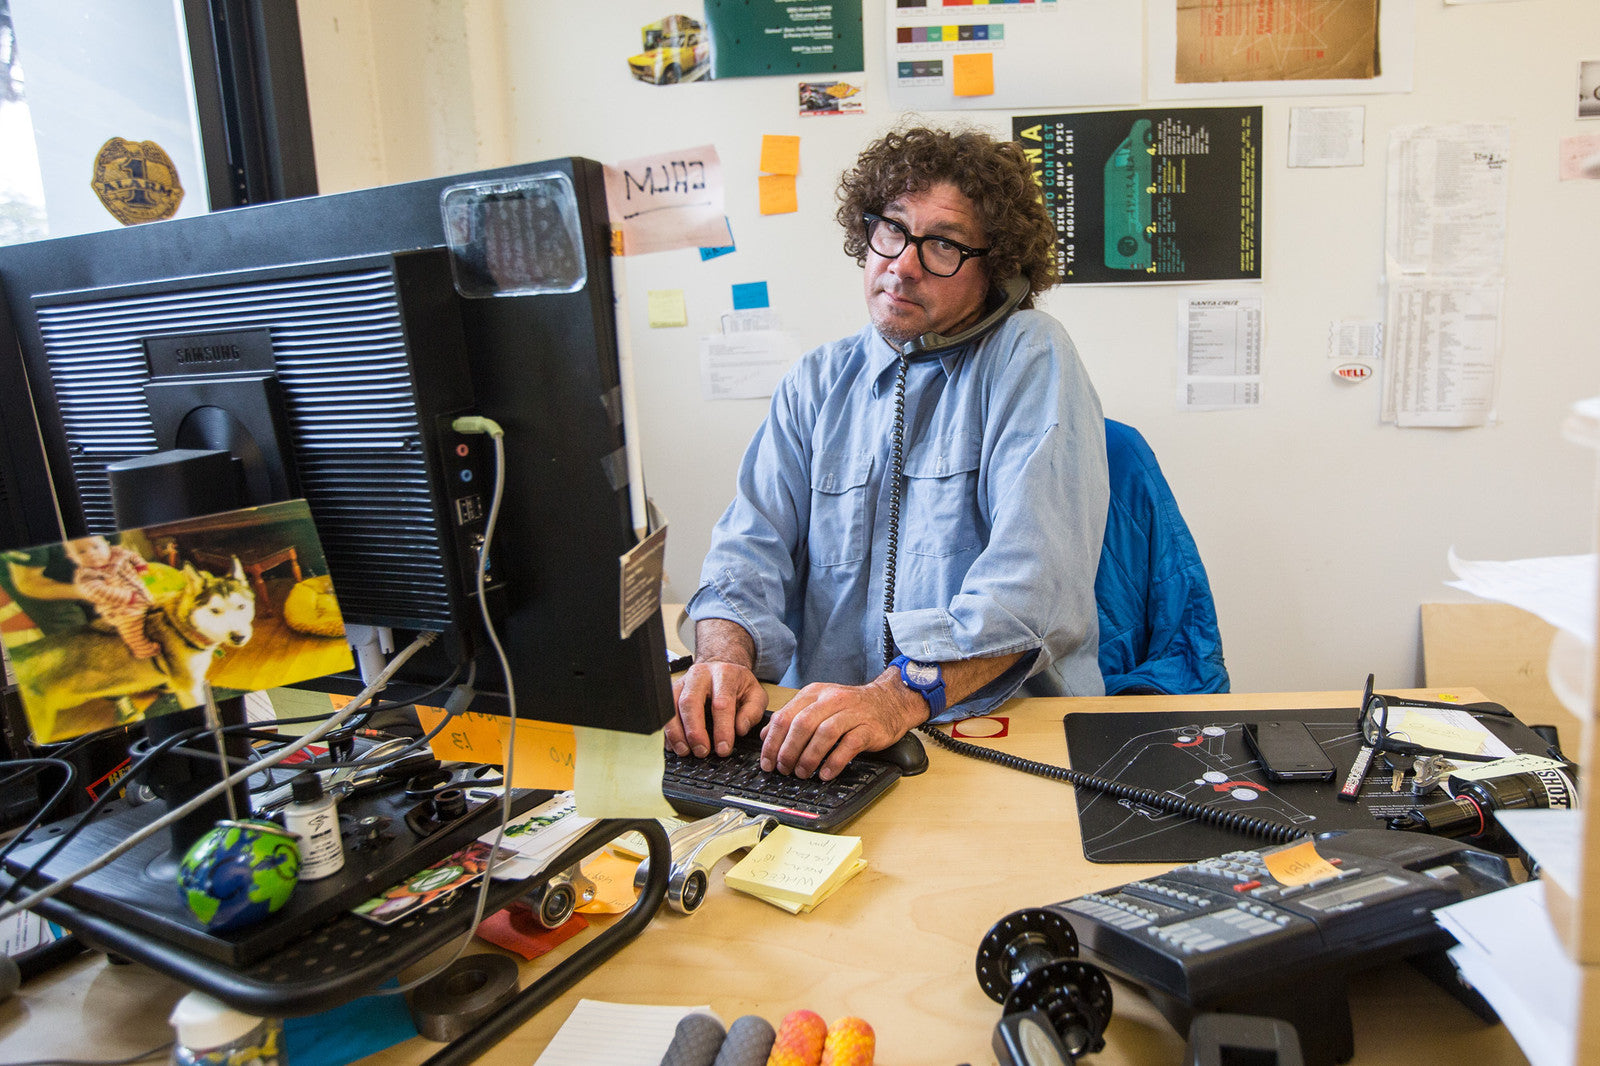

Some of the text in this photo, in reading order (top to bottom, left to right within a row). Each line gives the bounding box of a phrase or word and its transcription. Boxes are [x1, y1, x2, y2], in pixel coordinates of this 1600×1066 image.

[1055, 122, 1064, 142] PIC
[1044, 123, 1055, 186] CONTEST
[1146, 143, 1157, 156] 4.
[1056, 161, 1065, 187] SNAP
[104, 179, 173, 197] ALARM
[1146, 182, 1157, 194] 3.
[1056, 206, 1065, 232] BIKE
[1146, 221, 1157, 234] 2.
[1066, 244, 1075, 263] TAG
[1146, 261, 1157, 274] 1.
[176, 344, 241, 364] SAMSUNG
[1338, 368, 1367, 377] BELL
